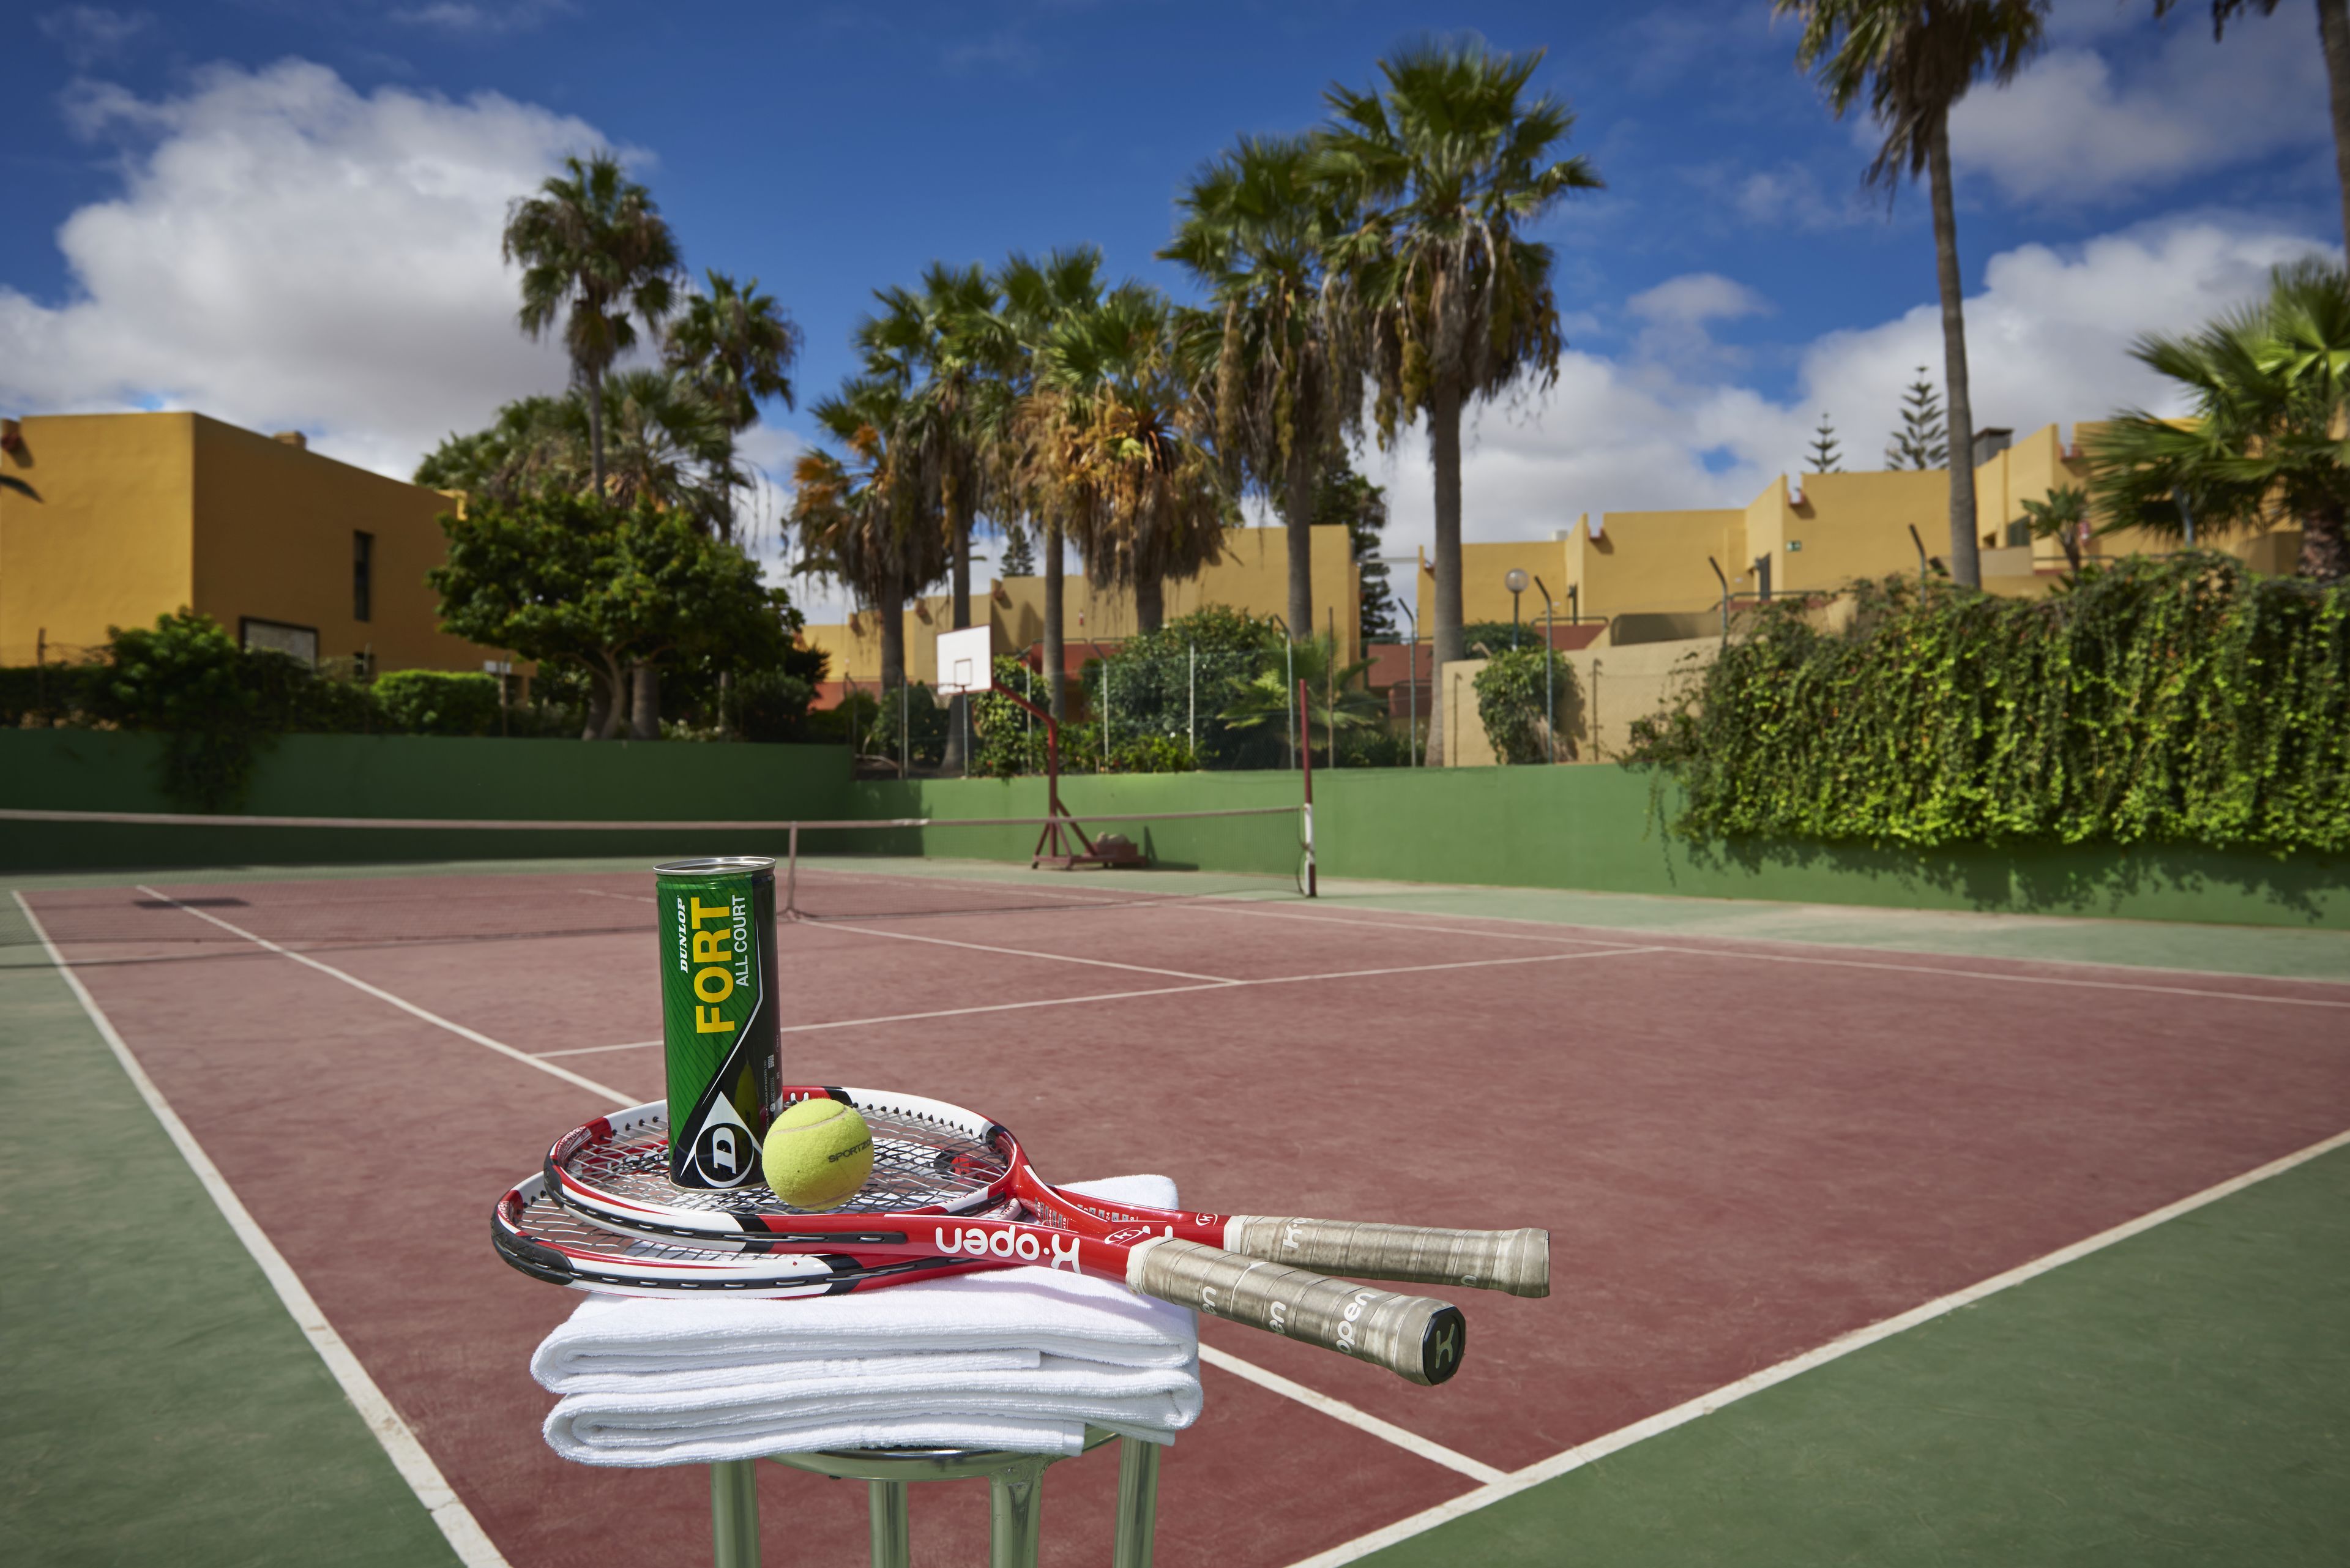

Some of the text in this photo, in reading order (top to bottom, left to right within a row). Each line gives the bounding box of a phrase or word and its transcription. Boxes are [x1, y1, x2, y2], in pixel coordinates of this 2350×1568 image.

[677, 897, 688, 974] DUNLOP
[691, 897, 735, 1034] FORT
[732, 894, 749, 987] ALL COURT
[827, 1136, 873, 1163] SPORTZO
